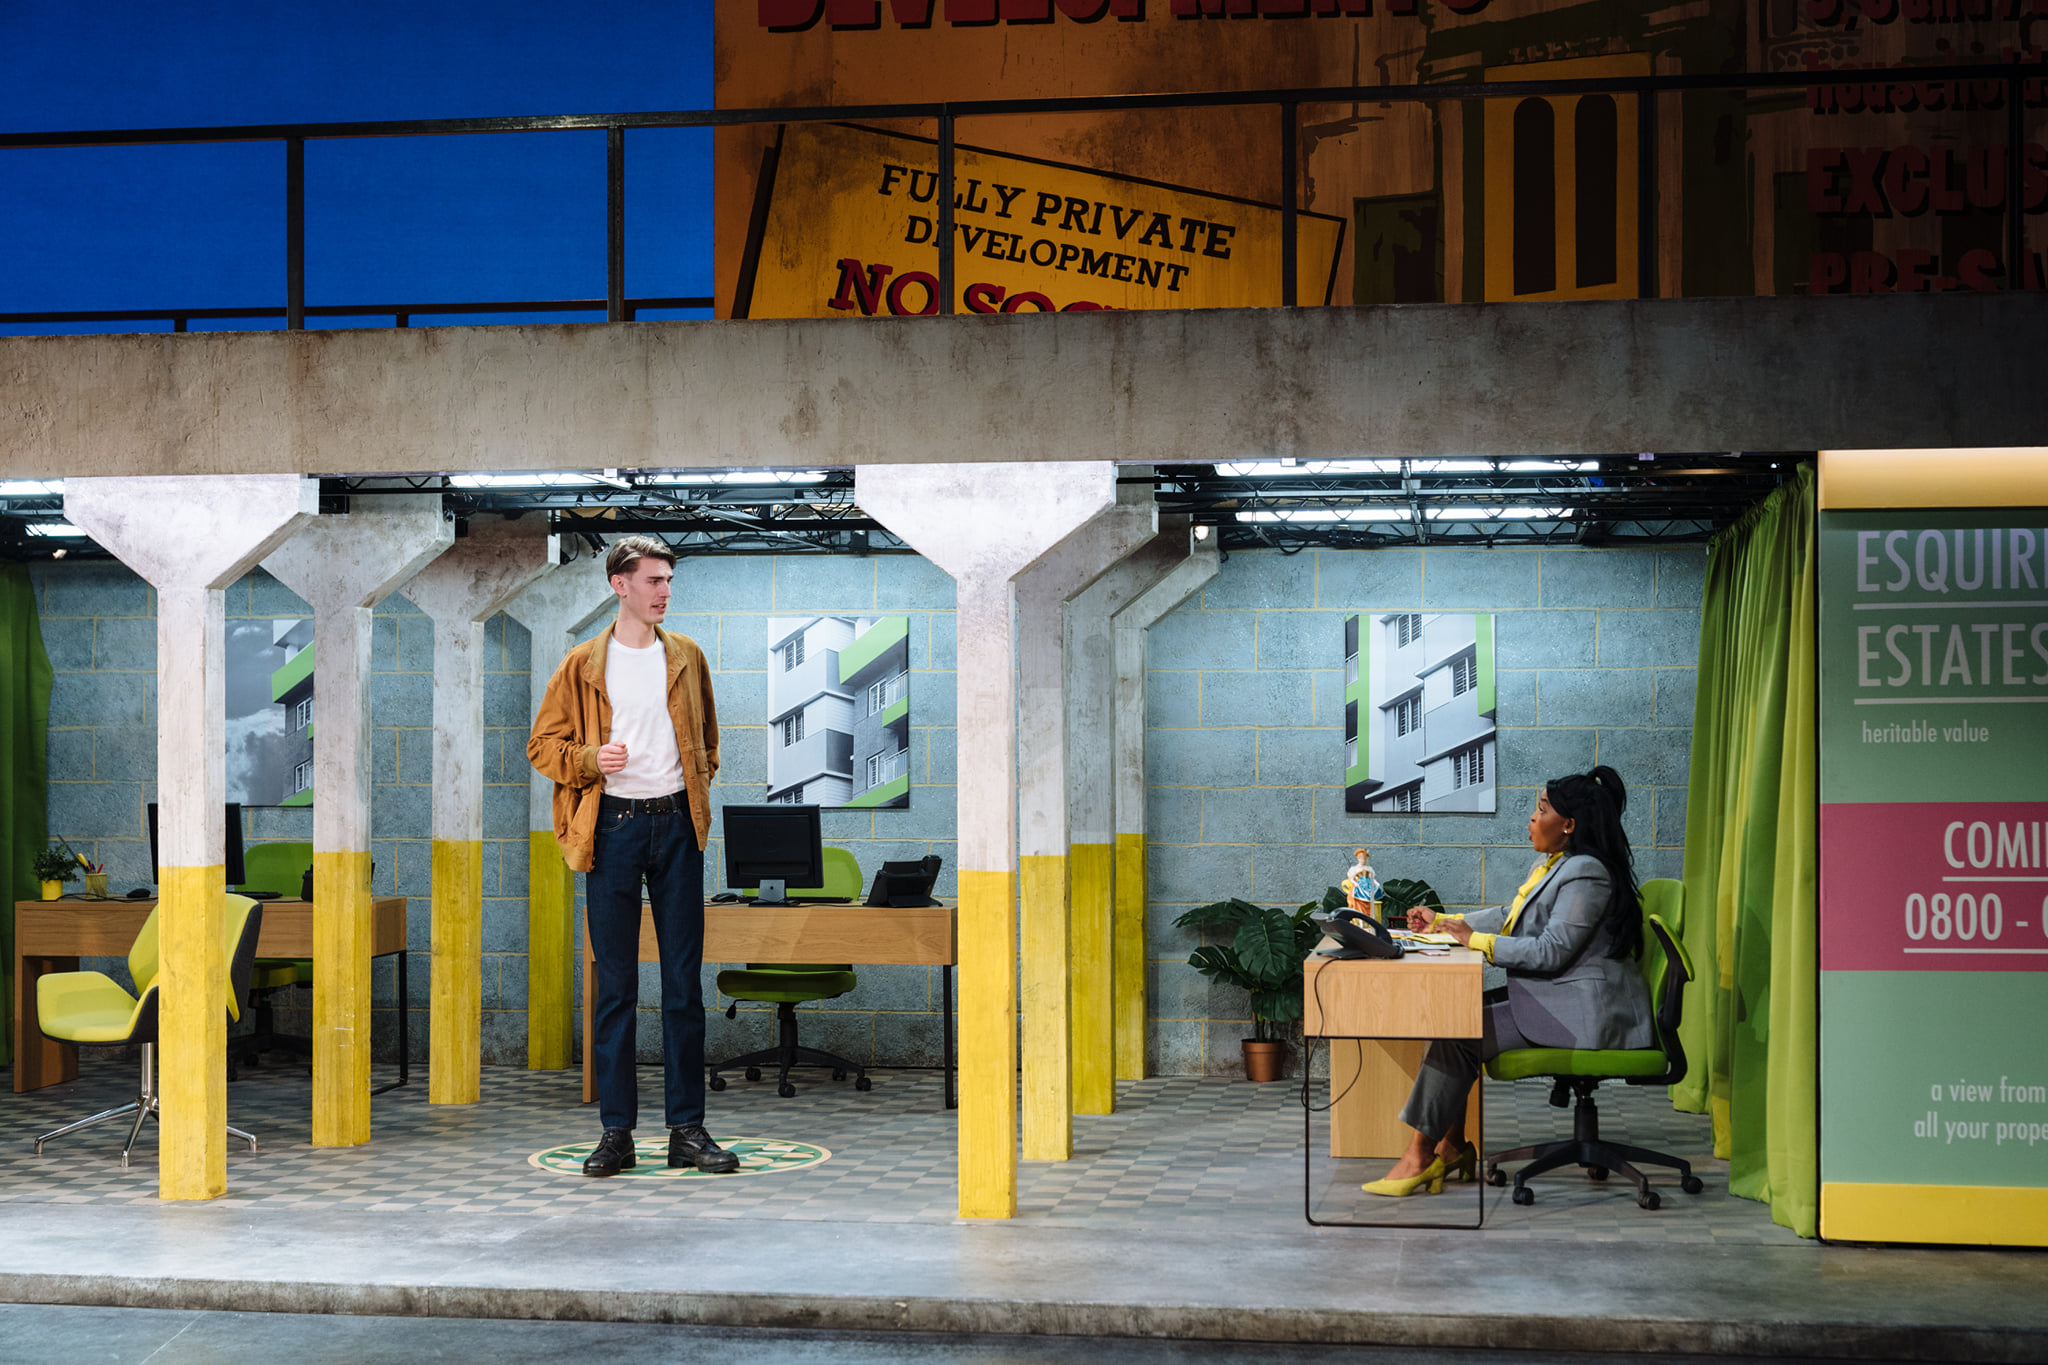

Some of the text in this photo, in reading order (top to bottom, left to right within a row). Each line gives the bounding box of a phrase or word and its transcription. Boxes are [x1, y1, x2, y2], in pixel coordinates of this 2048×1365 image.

[1031, 191, 1236, 260] PRIVATE
[828, 258, 939, 315] NO
[1857, 528, 2048, 594] ESQUIR
[1857, 622, 2048, 687] ESTATES
[1862, 719, 1989, 743] heritable value
[1943, 821, 2048, 869] COMI
[1905, 893, 2003, 940] 0800
[1931, 1075, 2046, 1103] a view from
[1914, 1111, 1938, 1138] all
[1945, 1121, 1990, 1144] your
